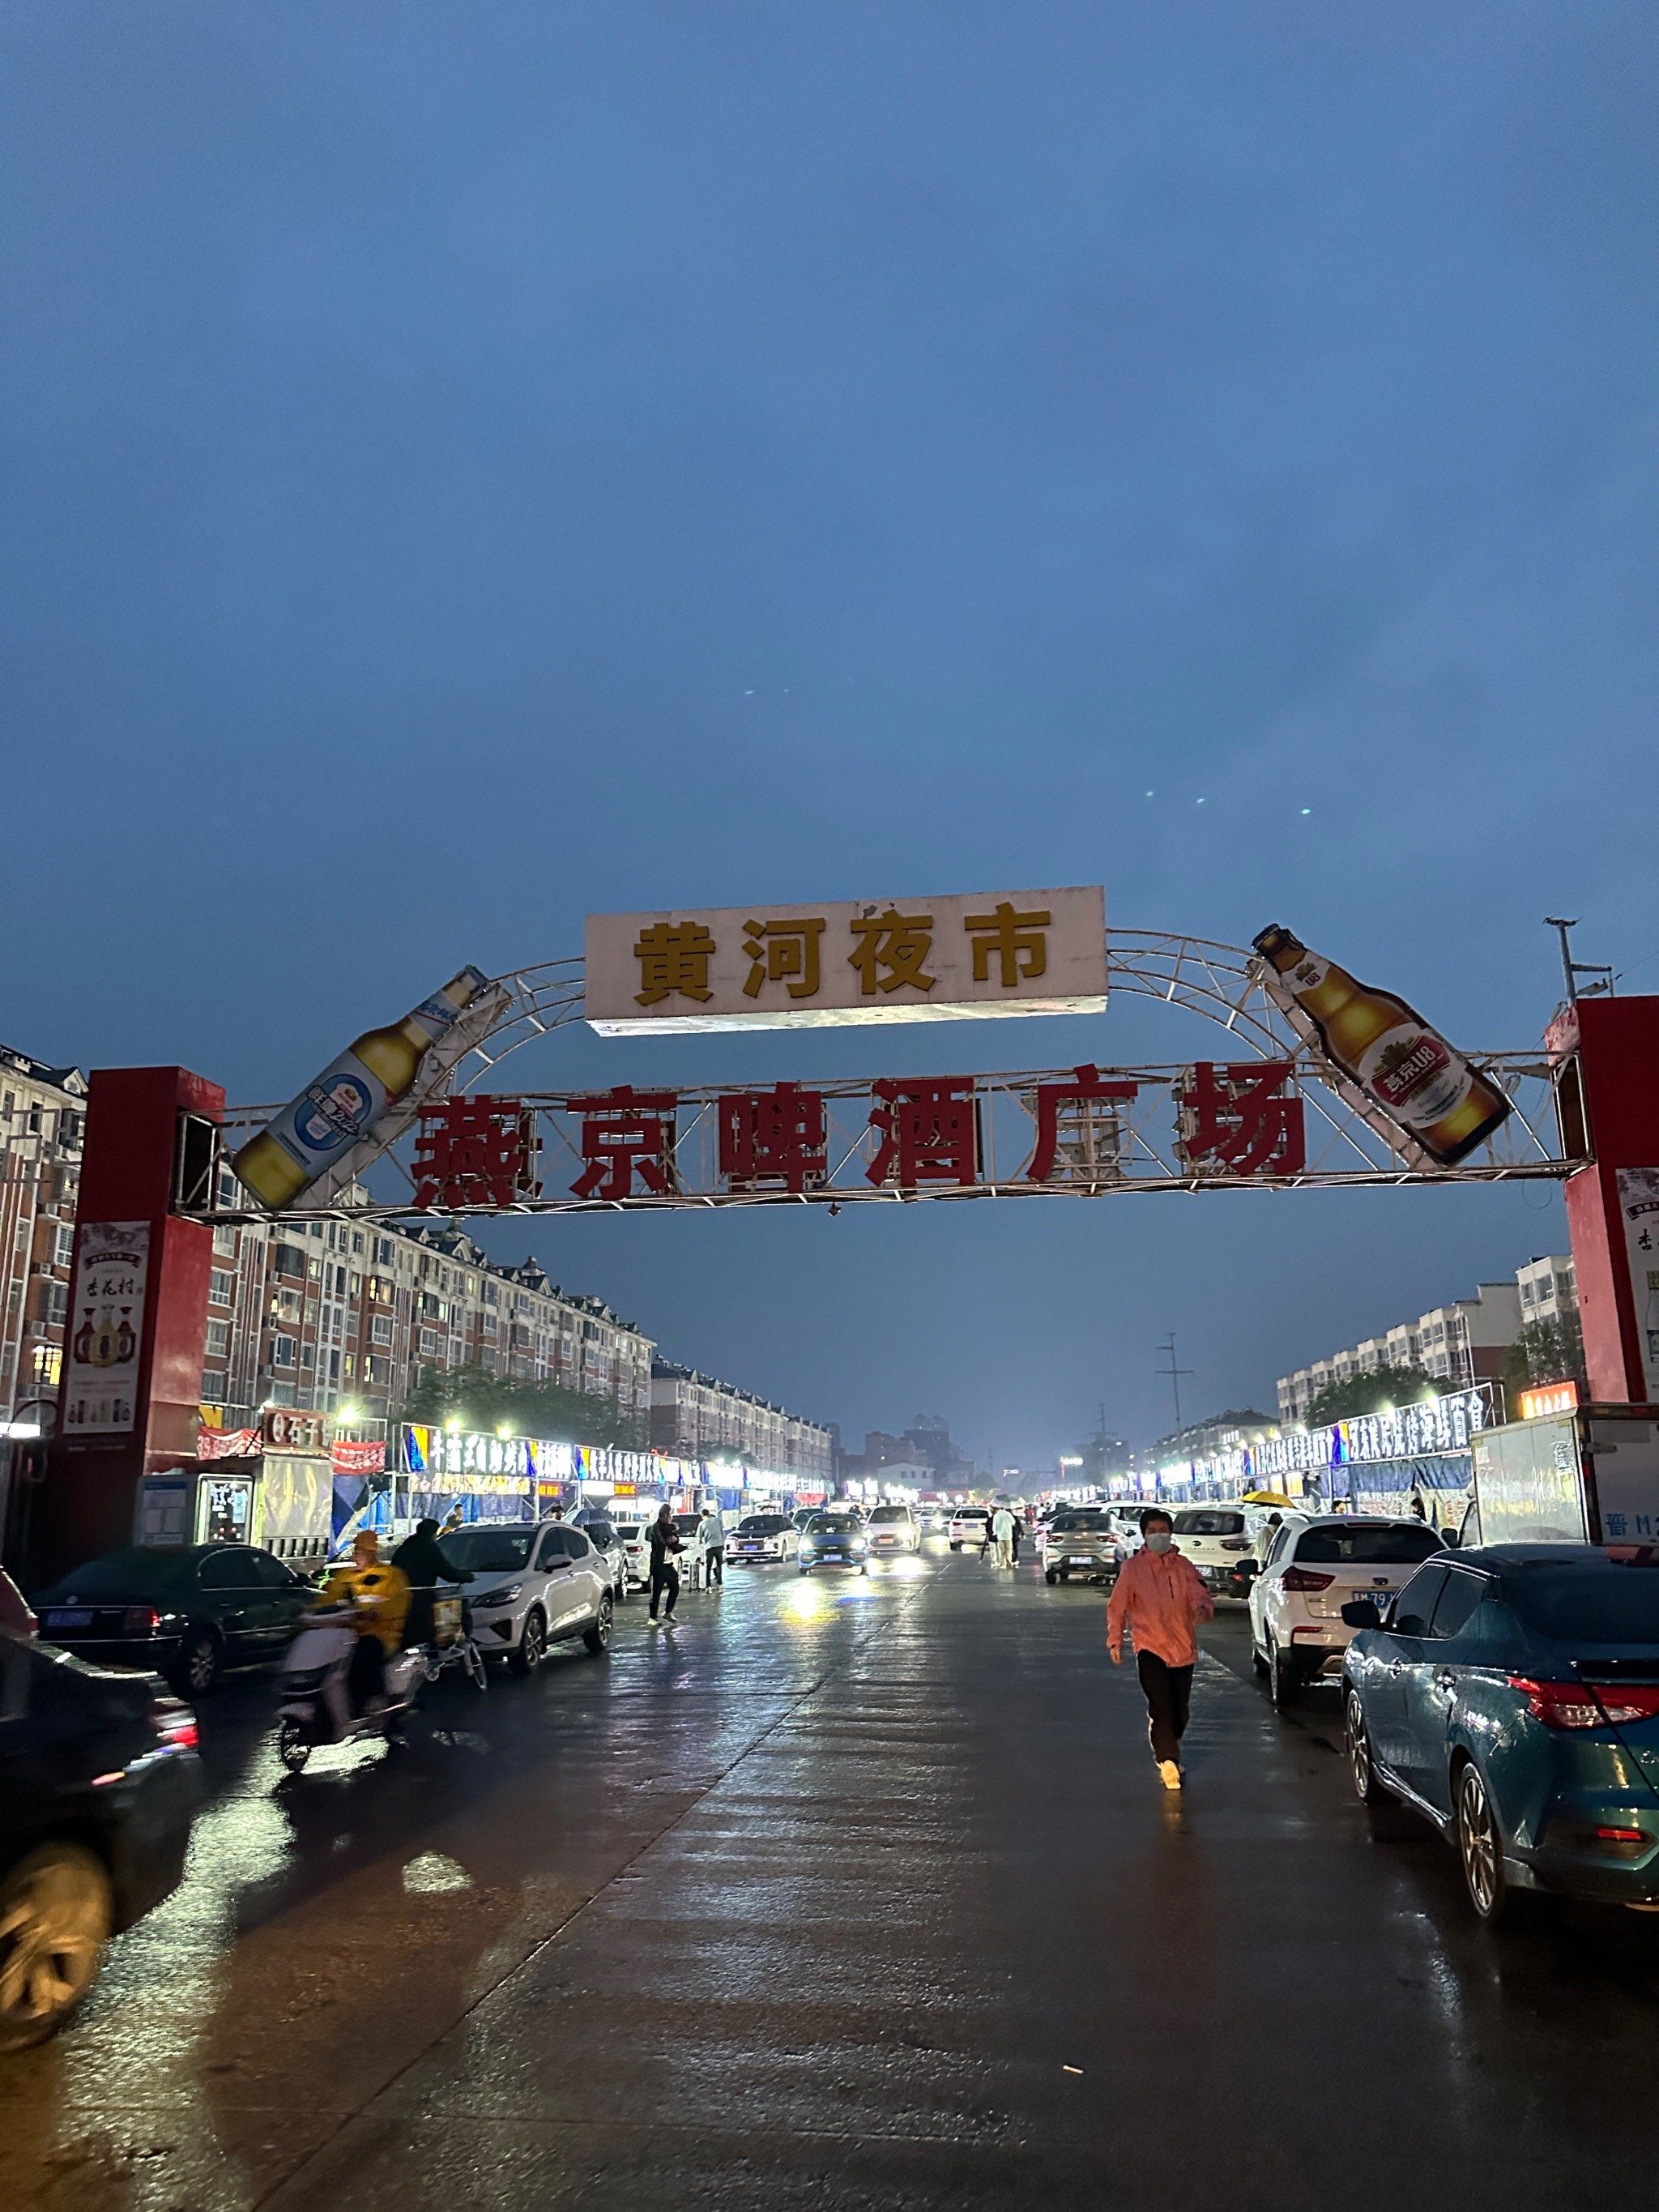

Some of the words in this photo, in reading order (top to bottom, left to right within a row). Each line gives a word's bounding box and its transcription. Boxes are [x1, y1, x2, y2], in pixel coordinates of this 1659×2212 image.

[633, 902, 1051, 1006] 黄河夜市
[1382, 1045, 1436, 1092] 燕京U8
[412, 1062, 1306, 1210] 燕京啤酒广场
